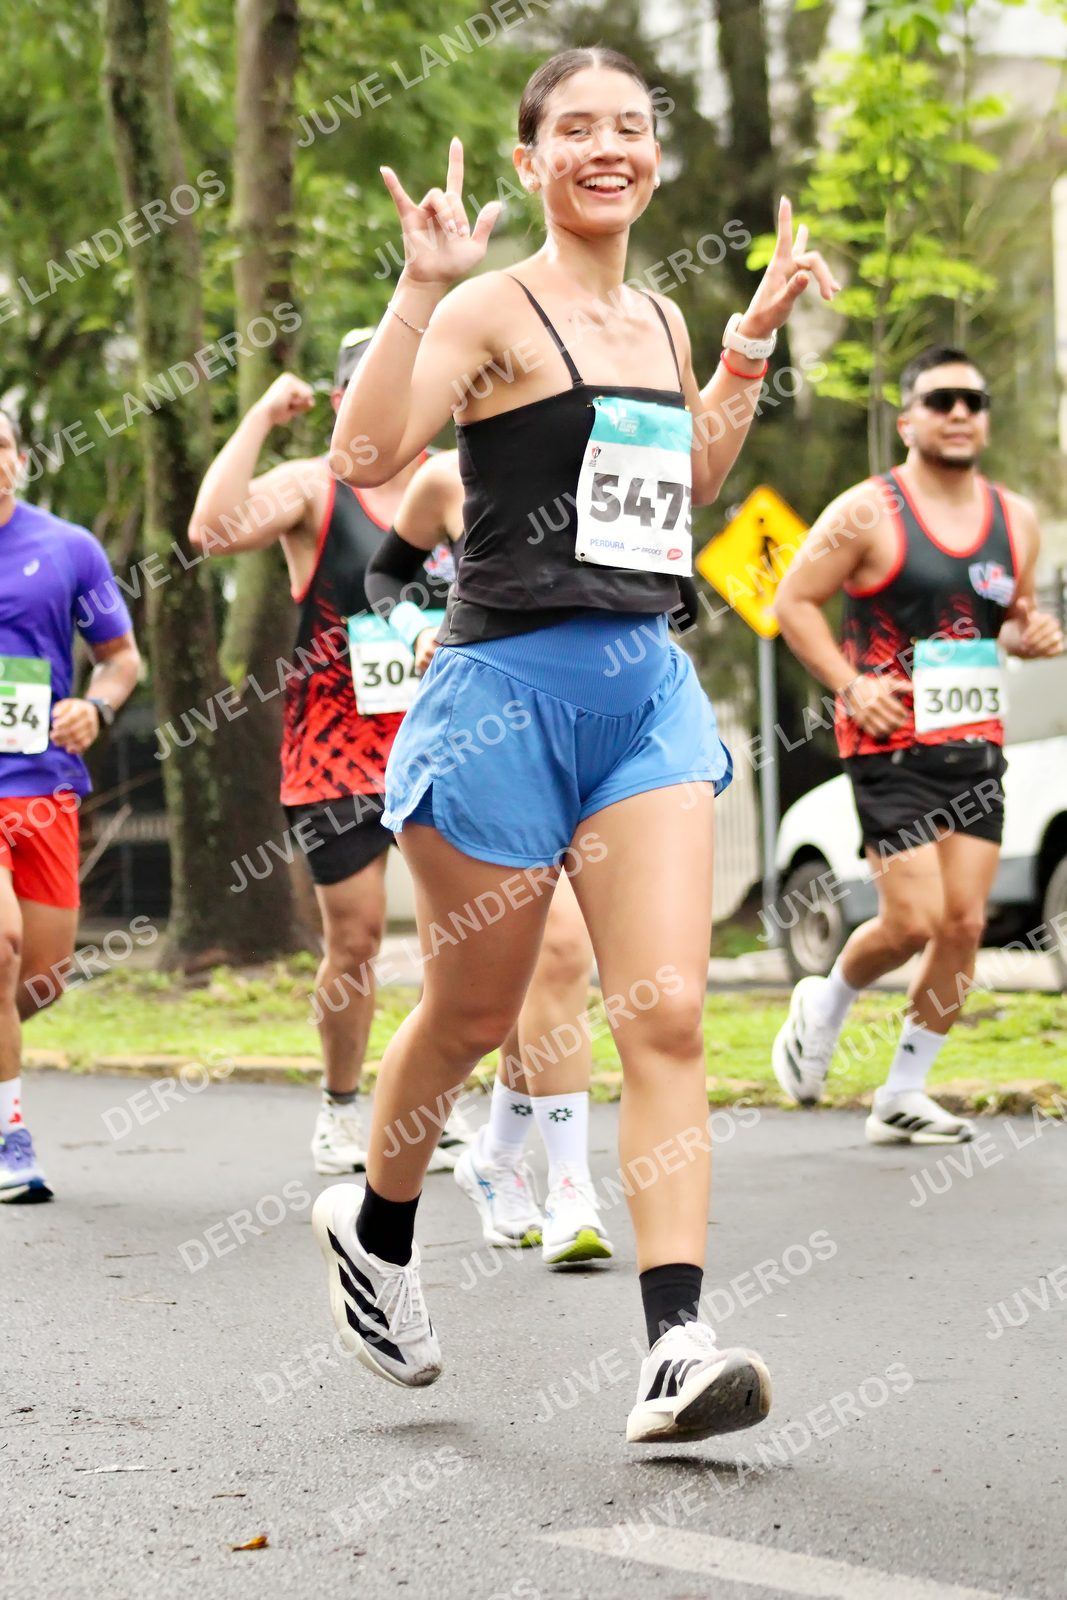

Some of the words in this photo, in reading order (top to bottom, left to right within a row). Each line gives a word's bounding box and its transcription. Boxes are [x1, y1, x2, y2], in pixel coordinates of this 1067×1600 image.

[589, 472, 692, 537] 547
[589, 538, 625, 551] PERDURA
[924, 687, 1000, 714] 3003
[0, 702, 40, 729] 34
